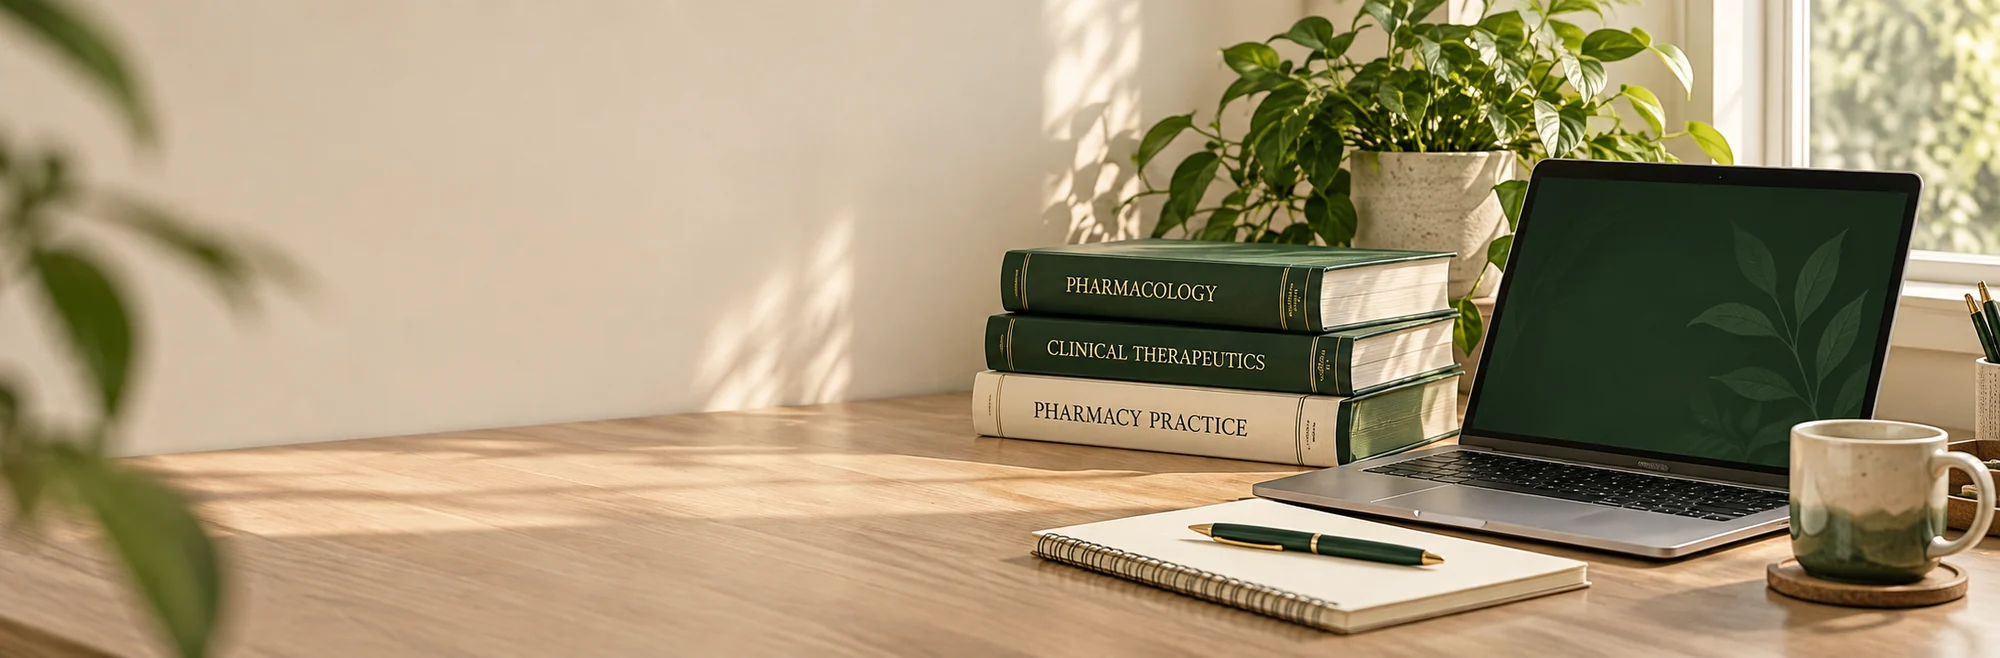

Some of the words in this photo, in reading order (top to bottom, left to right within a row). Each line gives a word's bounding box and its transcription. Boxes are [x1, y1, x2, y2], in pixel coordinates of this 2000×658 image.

[1066, 276, 1218, 303] PHARMACOLOGY
[1046, 339, 1128, 361] CLINICAL
[1132, 345, 1266, 371] THERAPEUTICS
[1033, 401, 1143, 429] PHARMACY
[1149, 410, 1248, 438] PRACTICE
